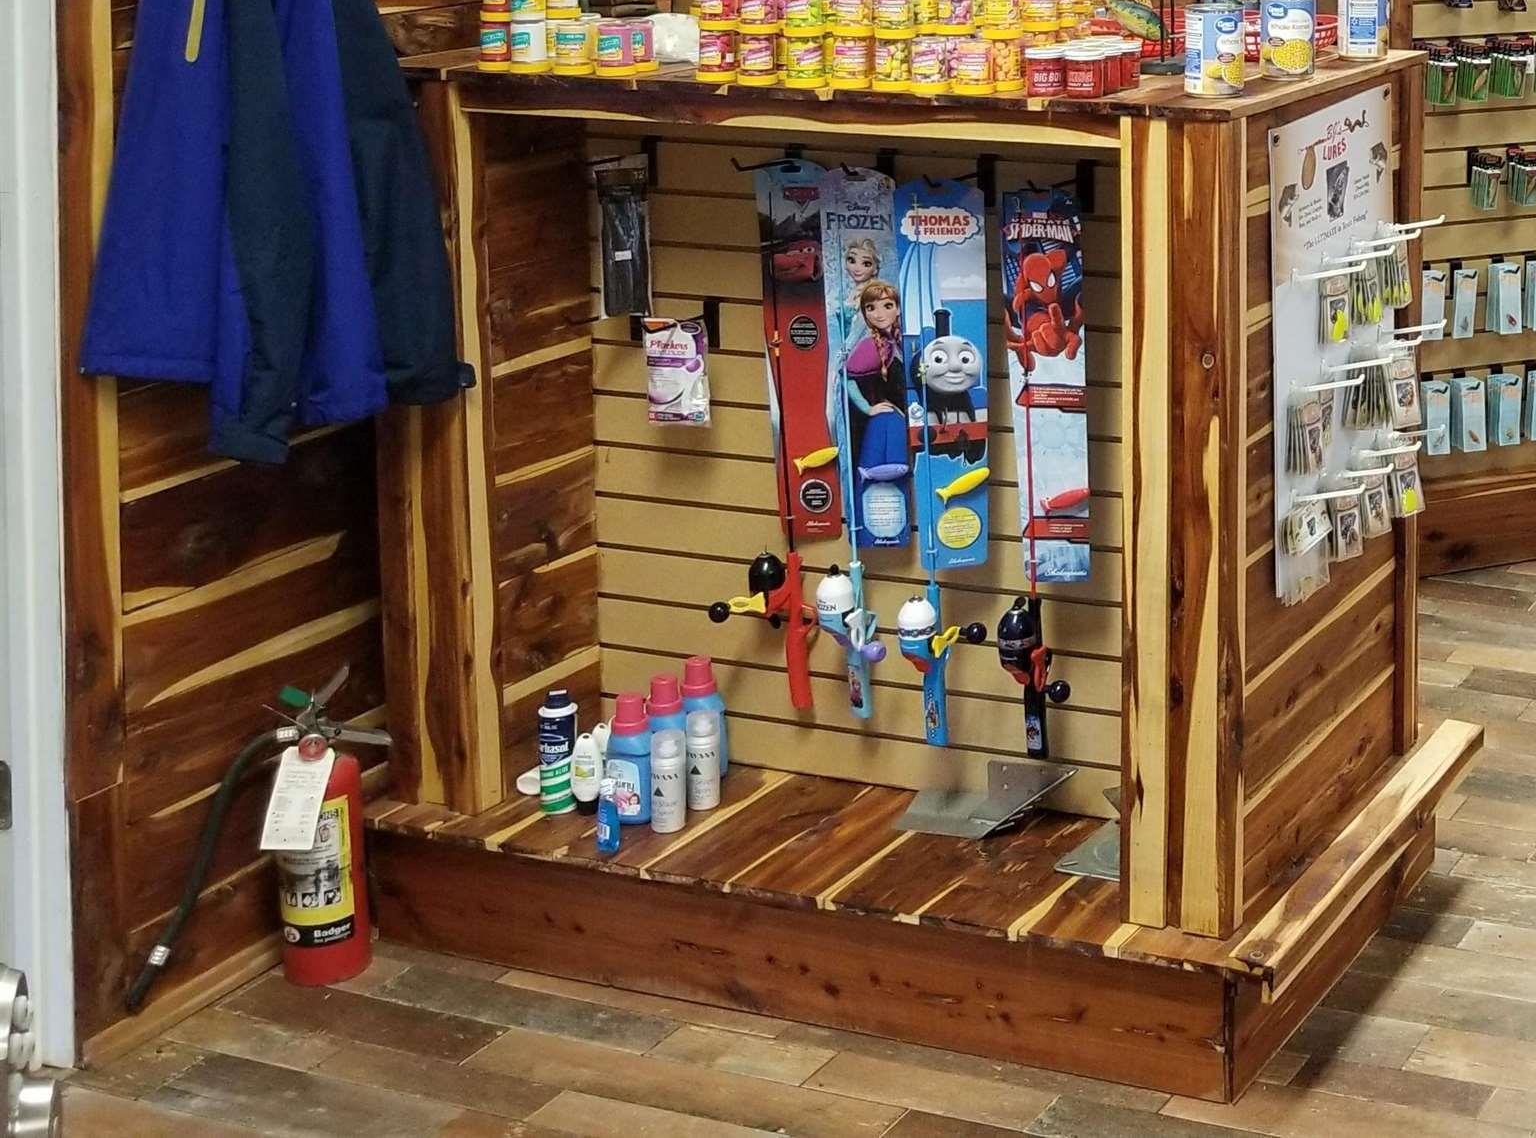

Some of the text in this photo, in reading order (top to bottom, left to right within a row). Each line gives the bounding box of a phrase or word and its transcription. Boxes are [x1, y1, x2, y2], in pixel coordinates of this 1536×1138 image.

[1034, 71, 1048, 82] BIG
[1323, 138, 1347, 161] LURES
[826, 213, 893, 231] FROZEN
[908, 215, 971, 227] THOMAS
[923, 227, 967, 236] FRIENDS
[314, 922, 351, 938] Badger
